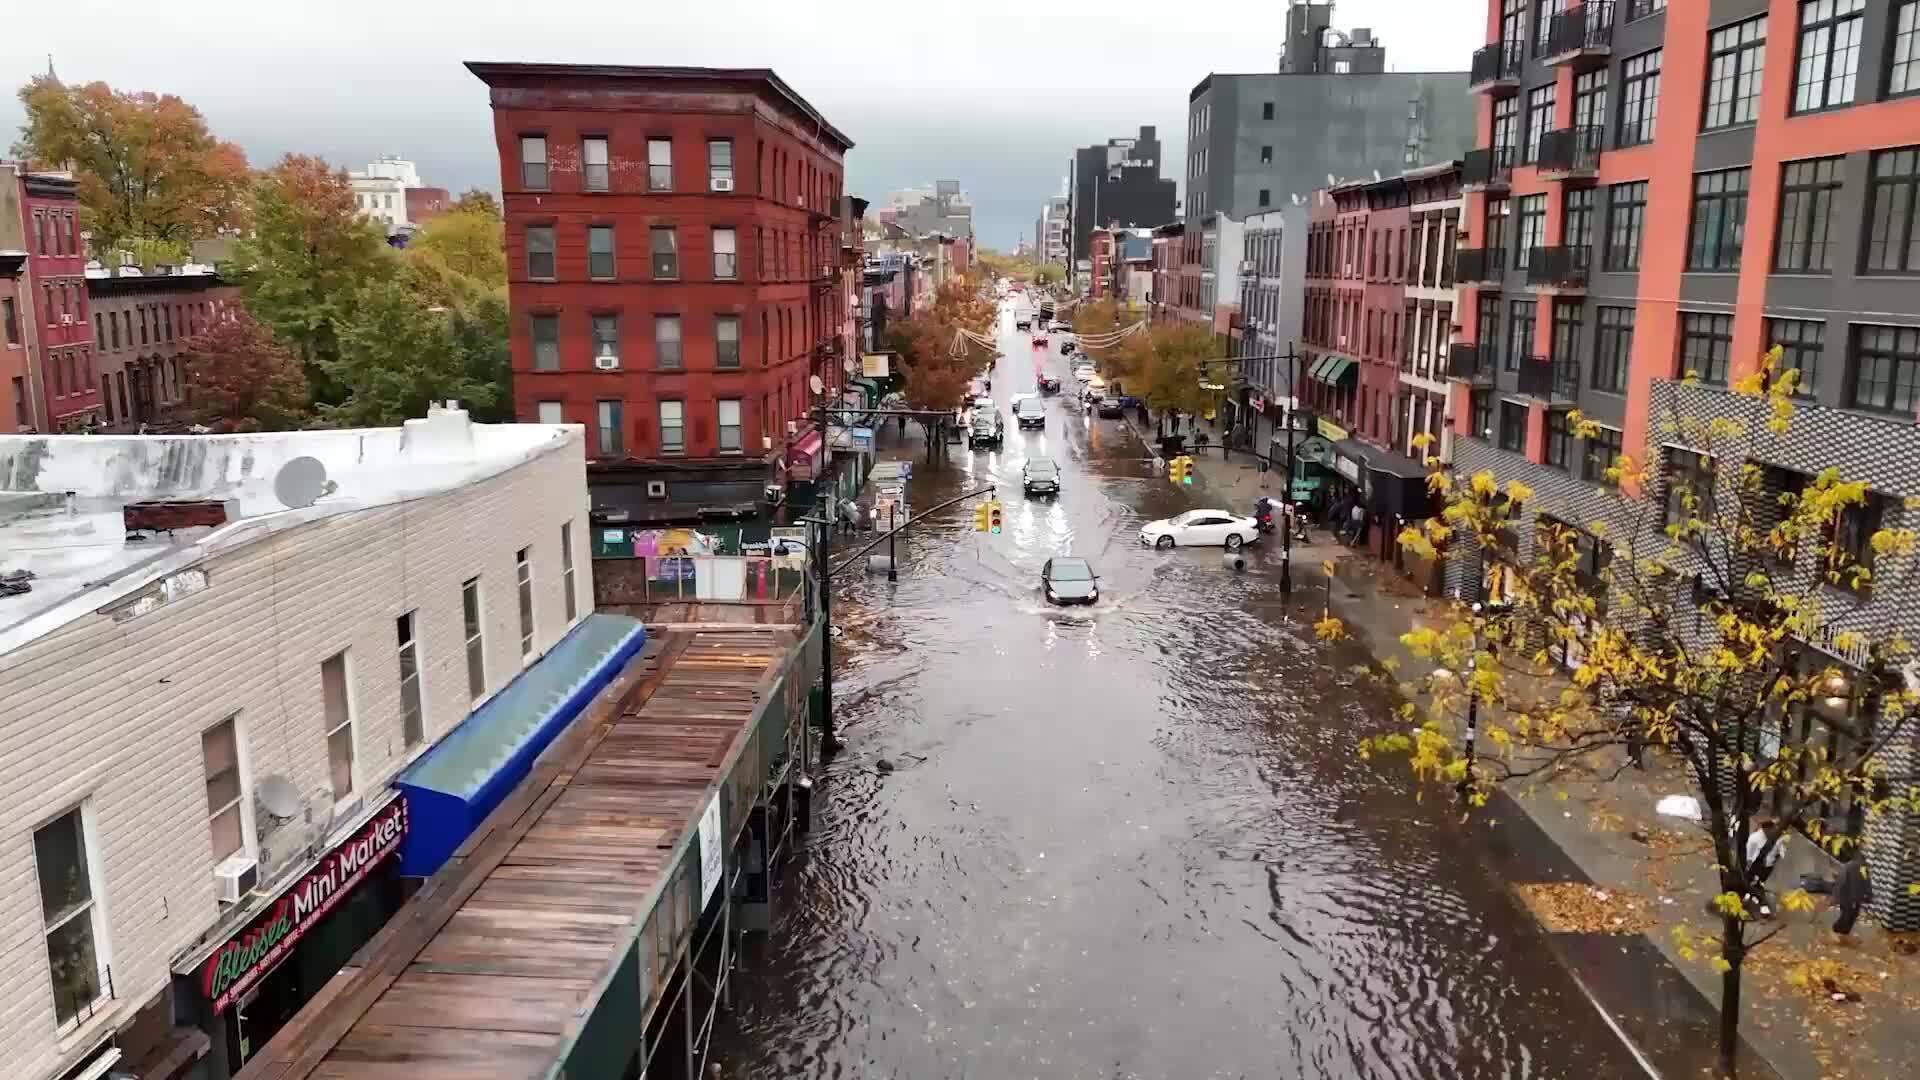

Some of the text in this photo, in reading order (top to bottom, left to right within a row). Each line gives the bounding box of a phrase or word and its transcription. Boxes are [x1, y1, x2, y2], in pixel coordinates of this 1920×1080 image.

[211, 900, 292, 999] Blessed
[294, 862, 337, 924] Mini
[340, 807, 403, 882] Market
